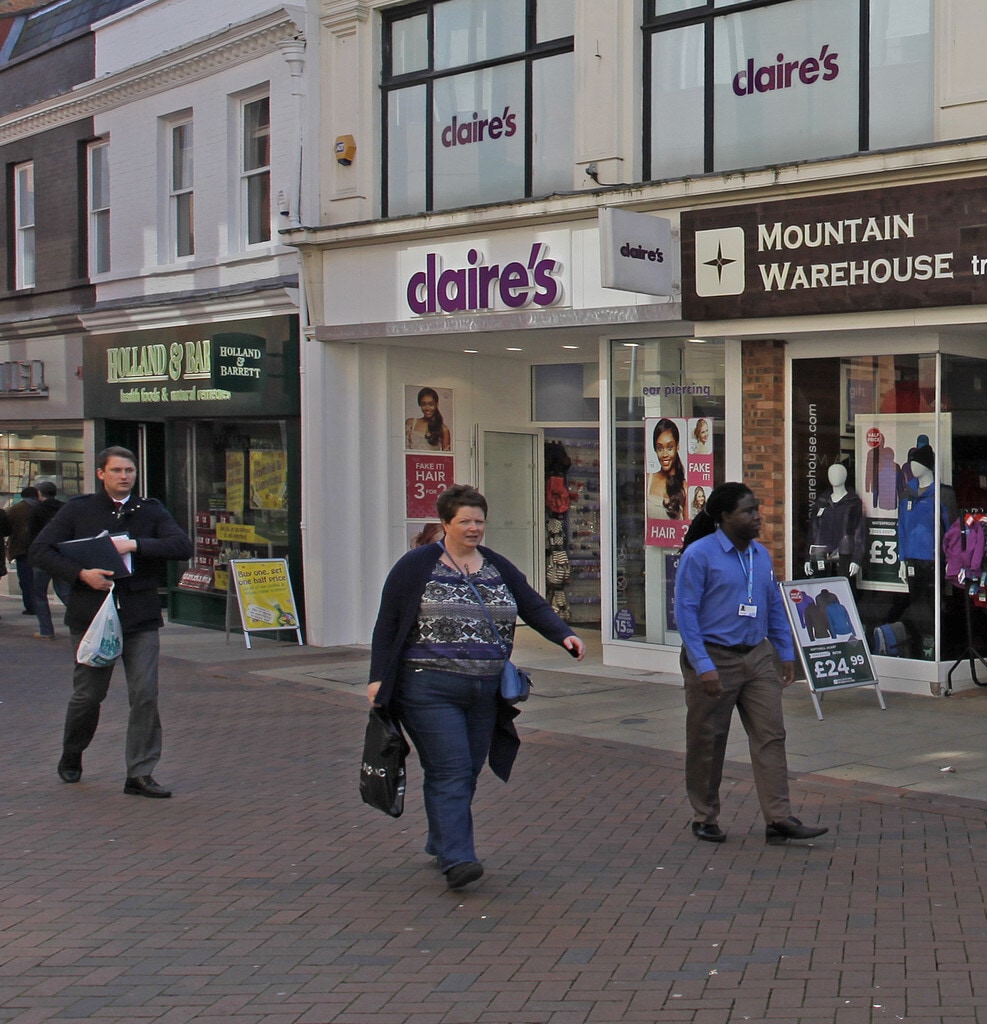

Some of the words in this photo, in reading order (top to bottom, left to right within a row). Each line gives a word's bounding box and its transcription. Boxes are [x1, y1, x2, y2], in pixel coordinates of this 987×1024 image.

[732, 44, 840, 97] claire's
[441, 106, 517, 149] claire's
[757, 212, 915, 252] MOUNTAIN
[620, 242, 664, 264] claire's
[406, 242, 563, 315] claire's
[758, 252, 954, 292] WAREHOUSE
[220, 346, 261, 360] HOLLAND
[107, 344, 167, 383] HOLLAND
[169, 342, 183, 381] &
[236, 357, 246, 367] &
[220, 365, 261, 379] BARRETT
[643, 386, 661, 396] ear
[665, 383, 711, 398] piercing
[415, 462, 434, 470] FAKE
[688, 462, 711, 473] FAKE
[415, 471, 446, 481] HAIR
[414, 482, 425, 499] 3
[651, 526, 676, 539] HAIR
